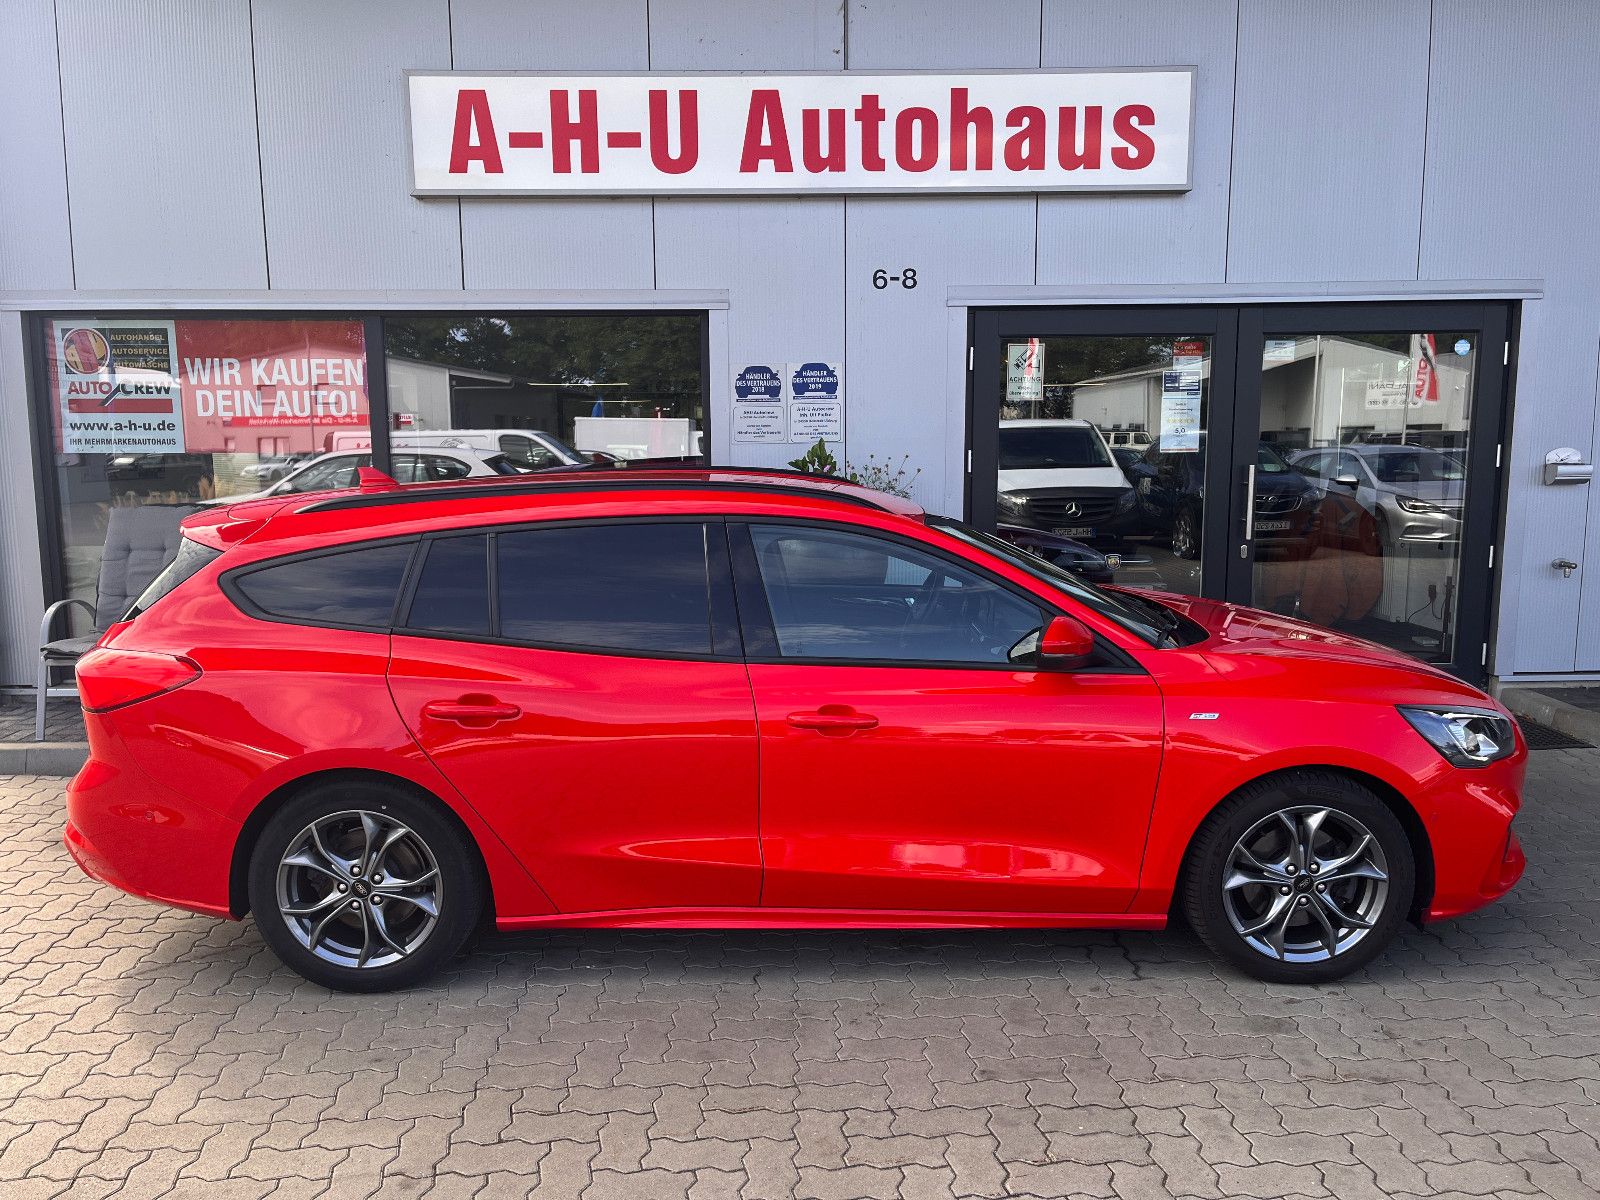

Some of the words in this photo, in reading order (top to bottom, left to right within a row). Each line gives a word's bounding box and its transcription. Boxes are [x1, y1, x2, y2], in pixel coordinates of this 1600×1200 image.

[449, 90, 699, 174] A-H-U
[740, 88, 1155, 172] Autohaus
[872, 268, 918, 289] 6-8
[110, 333, 165, 341] AUTOHANDEL
[111, 347, 168, 355] AUTOSERVICE
[184, 357, 242, 386] WIR
[251, 358, 364, 386] KAUFEN
[802, 369, 827, 377] HÄNDLER
[745, 372, 771, 380] HÄNDLER
[803, 376, 838, 384] VERTRAUENS
[747, 379, 781, 387] VERTRAUENS
[195, 389, 263, 417] DEIN
[272, 390, 358, 418] AUTO!
[69, 419, 176, 431] www.a-h-u.de
[70, 438, 82, 446] IHR
[84, 438, 177, 446] MEHRMARKENAUTOHAUS
